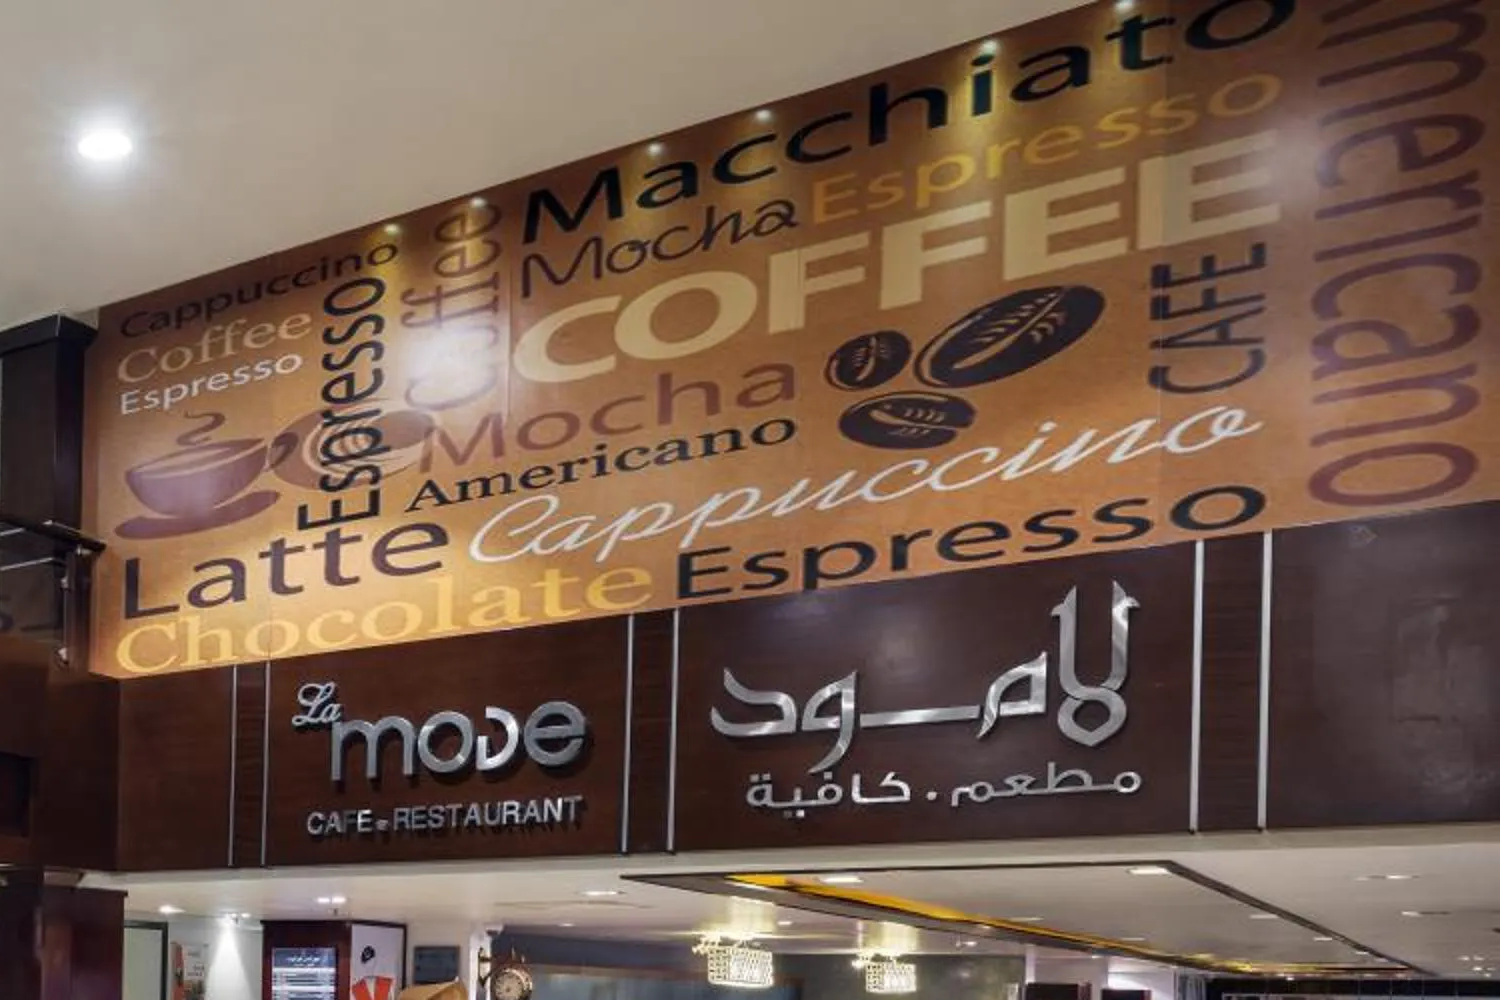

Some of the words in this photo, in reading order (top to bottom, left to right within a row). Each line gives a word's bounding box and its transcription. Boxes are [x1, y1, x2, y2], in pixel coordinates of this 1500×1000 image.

[521, 0, 1296, 245] Macchiato
[812, 73, 1283, 226] Espresso
[120, 243, 399, 338] Cappuccino
[514, 129, 1282, 383] COFFEE
[520, 199, 799, 298] Mocha
[1308, 0, 1488, 507] mericano
[117, 313, 312, 383] Coffee
[1148, 242, 1266, 394] CAFE
[120, 353, 304, 415] Espresso
[297, 276, 387, 531] Espresso
[419, 363, 796, 472] Mocha
[405, 418, 799, 512] Americano
[468, 405, 1263, 564] Cappuccino
[124, 523, 450, 620] Latte
[677, 485, 1266, 600] Espresso
[116, 566, 652, 675] Chocolate
[292, 682, 342, 726] La
[307, 808, 373, 835] CAFE
[393, 796, 583, 831] RESTAURANT
[950, 762, 1141, 808] مطعم
